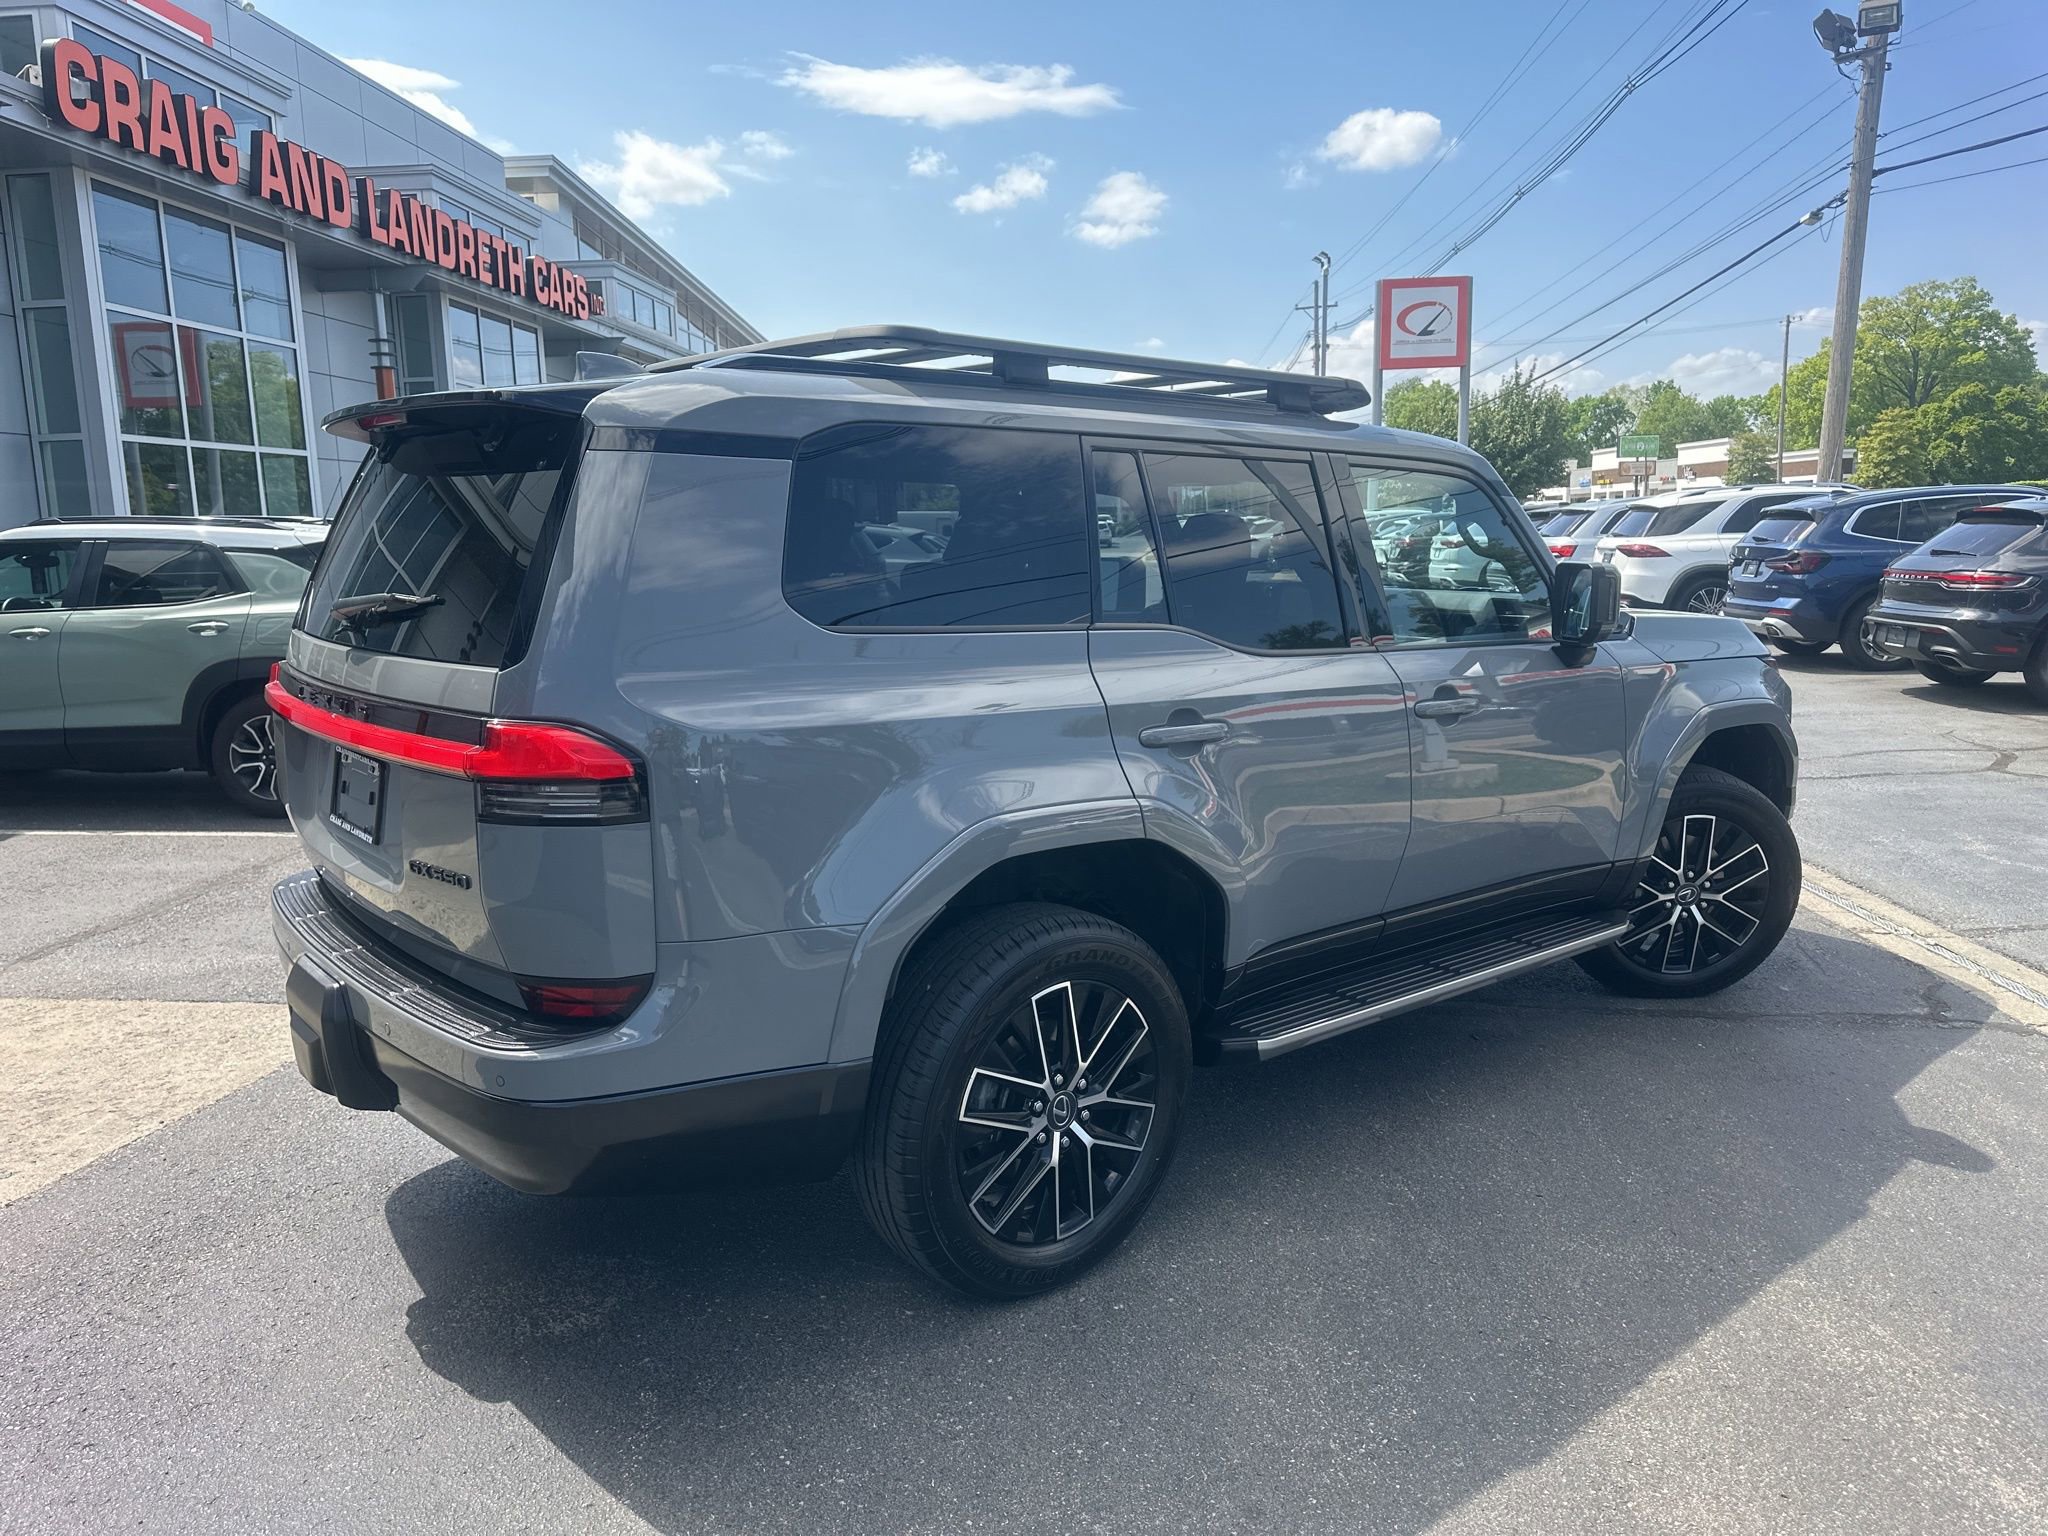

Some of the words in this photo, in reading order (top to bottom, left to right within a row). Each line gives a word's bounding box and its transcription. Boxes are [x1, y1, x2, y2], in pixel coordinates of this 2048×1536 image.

[49, 37, 239, 185] CRAIG
[257, 130, 352, 229] AND
[363, 177, 527, 297] LANDRETH
[532, 255, 589, 320] CARS
[409, 859, 472, 890] GX550
